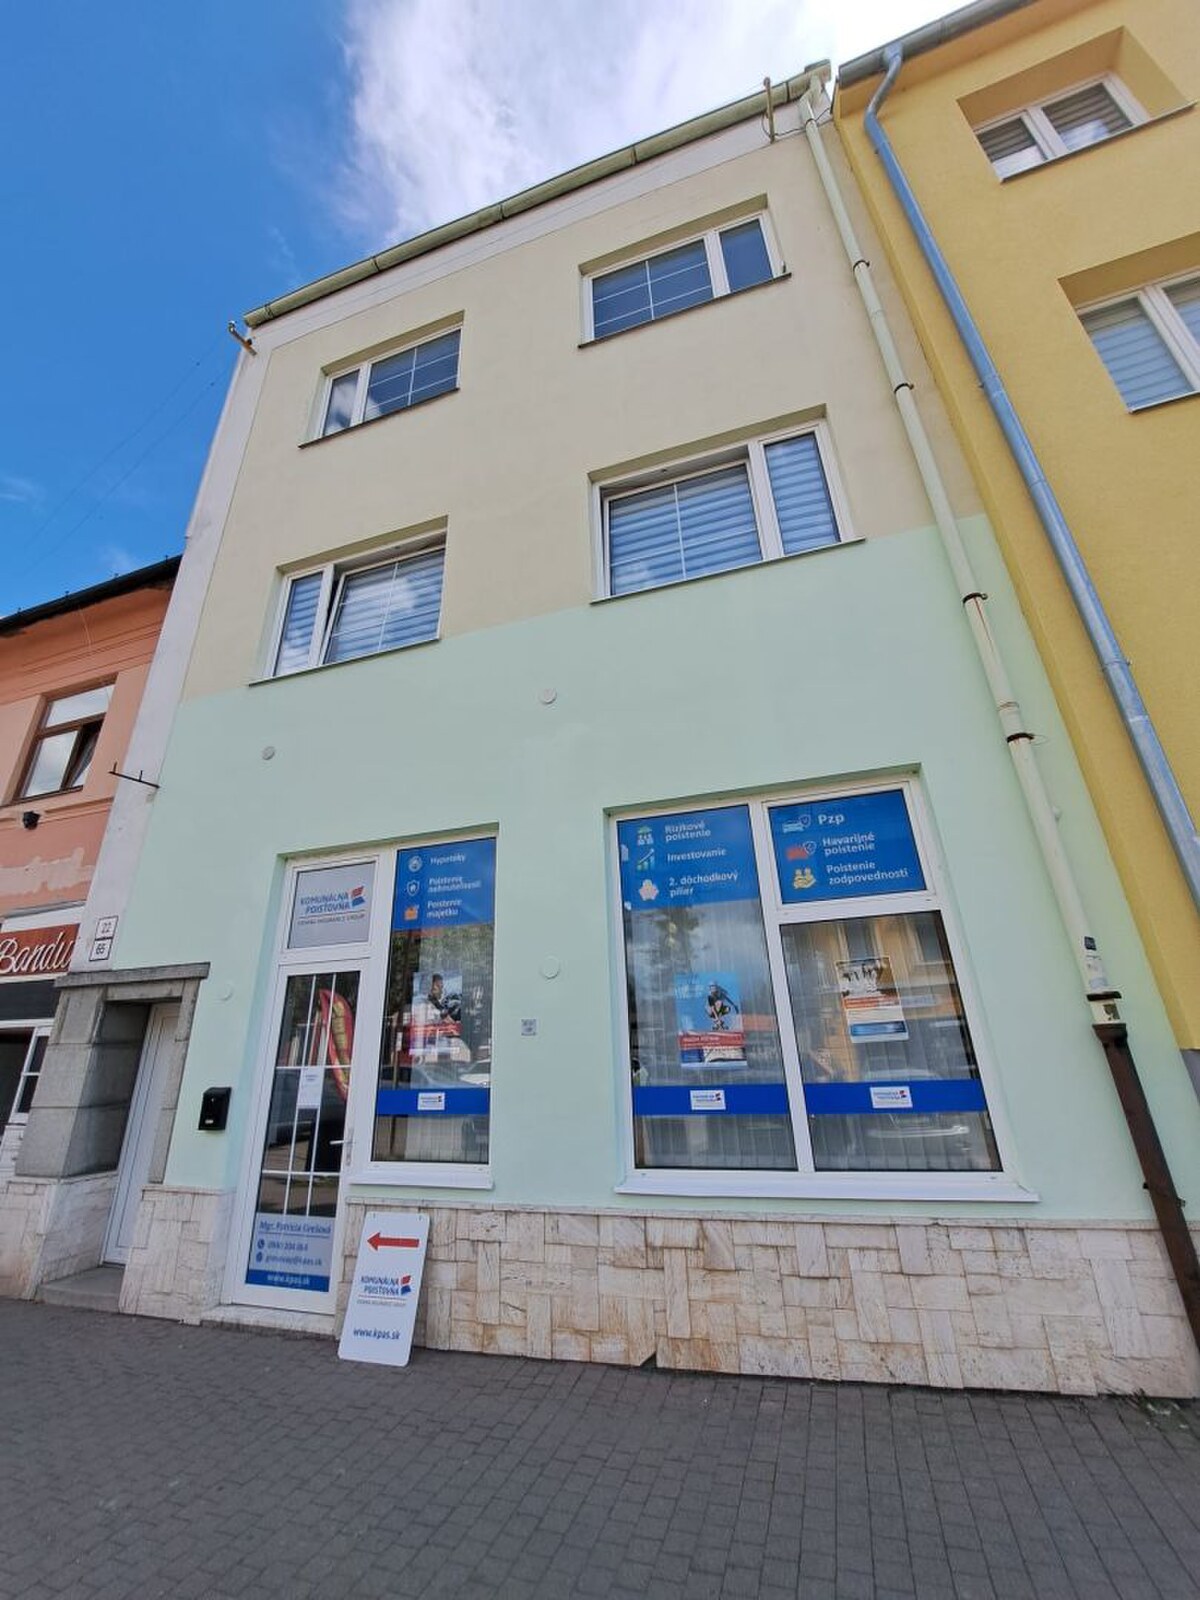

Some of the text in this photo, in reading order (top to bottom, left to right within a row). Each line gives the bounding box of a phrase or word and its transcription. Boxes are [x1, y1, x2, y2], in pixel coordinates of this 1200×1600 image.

[817, 813, 844, 825] Pzp
[665, 829, 711, 843] poistenie
[822, 832, 875, 847] Havarijné
[667, 848, 727, 862] Investovanie
[824, 842, 875, 857] poistenie
[826, 860, 875, 874] Poistenie
[668, 876, 678, 887] 2.
[829, 868, 908, 885] zodpovednosti
[300, 891, 349, 905] KOMUNÁLNA
[101, 921, 112, 934] 22
[353, 1328, 400, 1340] www.kpas.sk
